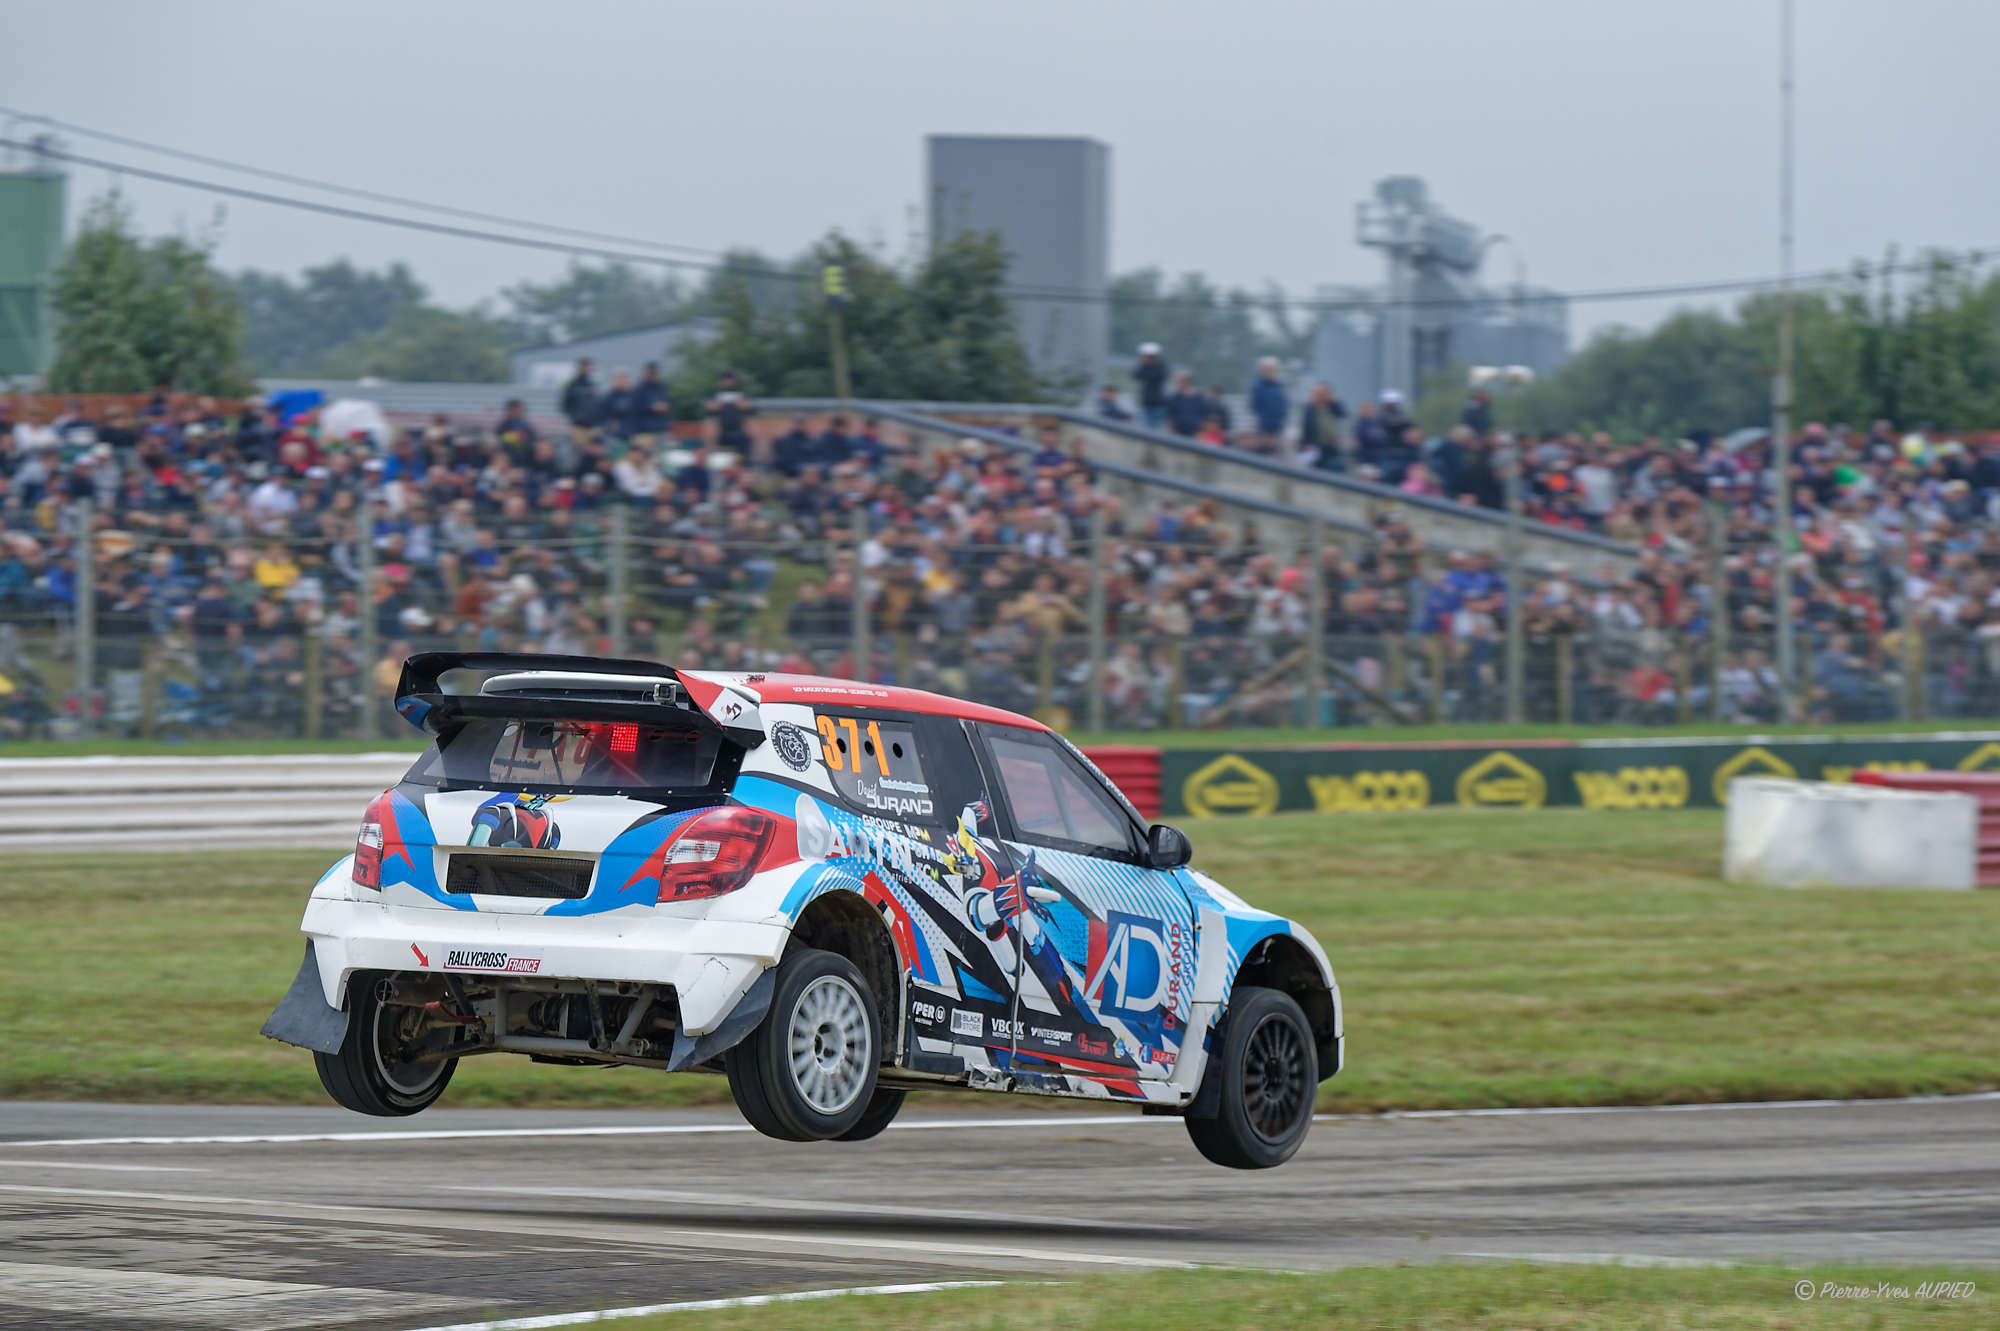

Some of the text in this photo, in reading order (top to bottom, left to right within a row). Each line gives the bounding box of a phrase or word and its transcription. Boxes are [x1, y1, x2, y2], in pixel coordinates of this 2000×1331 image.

[816, 715, 891, 777] 371
[866, 794, 934, 816] DURAND
[1307, 771, 1430, 814] YACCO
[1573, 766, 1688, 809] YACCO
[861, 814, 904, 833] GROUPE
[448, 951, 540, 972] RALLYCROSS FRANCE
[1163, 923, 1181, 1029] DURAND
